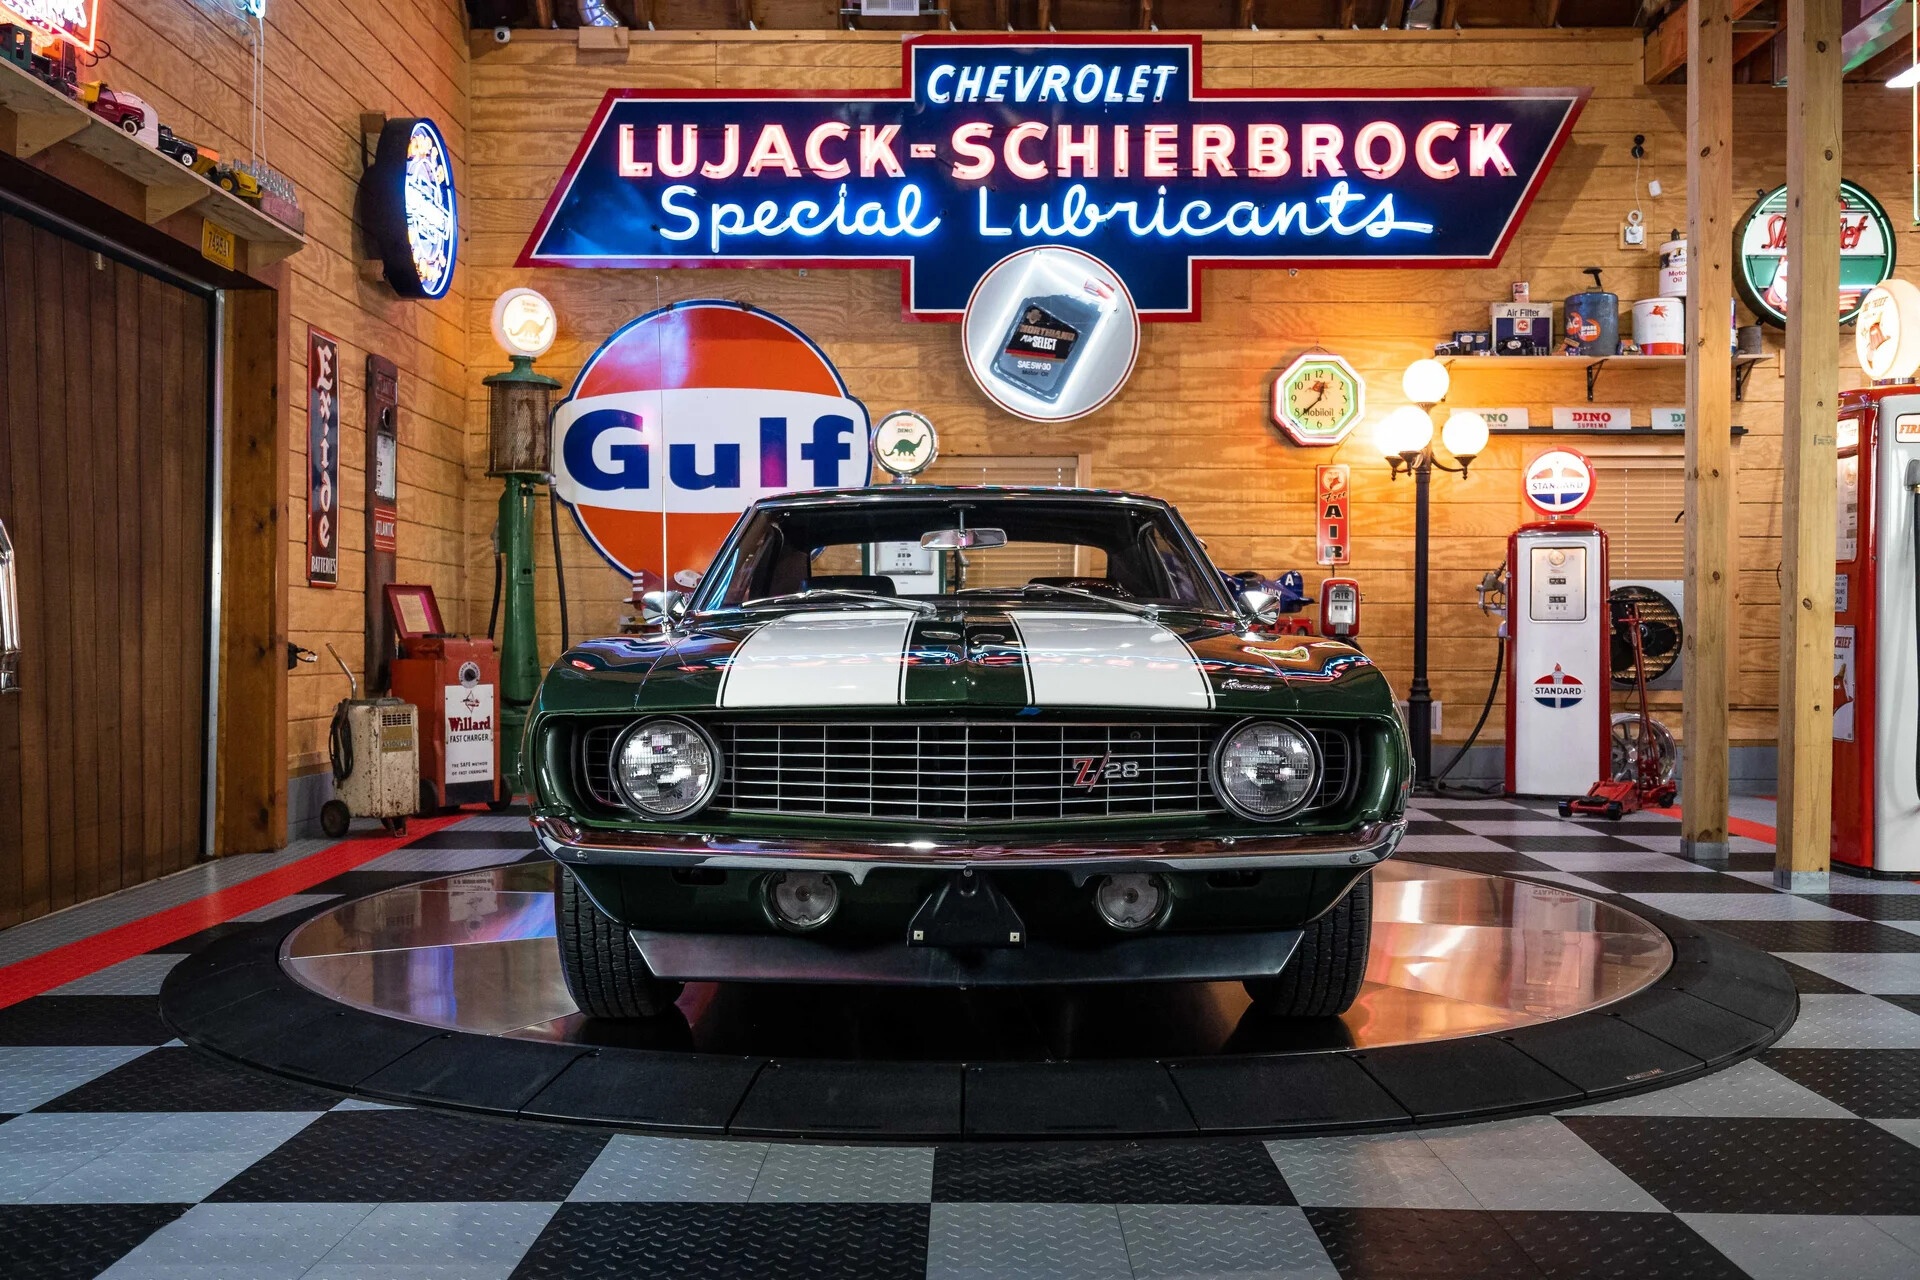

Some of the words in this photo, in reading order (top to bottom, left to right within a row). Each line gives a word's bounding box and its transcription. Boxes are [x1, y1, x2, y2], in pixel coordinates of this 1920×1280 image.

[927, 64, 1178, 103] CHEVROLET
[619, 121, 1517, 180] LUJACK-SCHIERBROCK
[659, 183, 941, 253] Special
[979, 181, 1434, 238] Lubricants
[1507, 309, 1518, 317] Air
[1520, 309, 1540, 317] Filter
[1566, 318, 1579, 329] AC
[1032, 336, 1058, 350] SELECT
[1304, 373, 1311, 381] 11
[1315, 369, 1324, 379] 12
[1294, 382, 1303, 390] 10
[1339, 382, 1344, 390] 2
[1291, 394, 1297, 402] 9
[1342, 394, 1348, 402] 3
[1294, 408, 1300, 417] 8
[1339, 408, 1344, 417] 4
[1572, 412, 1611, 422] DINO
[1304, 418, 1309, 426] 7
[1316, 421, 1323, 429] 6
[1331, 417, 1336, 425] 5
[563, 408, 854, 491] Gulf
[1323, 503, 1344, 559] AIR
[311, 556, 336, 575] BATTERIES
[1285, 574, 1294, 586] A
[1335, 592, 1350, 600] AIR
[1535, 687, 1582, 695] STANDARD
[448, 716, 491, 732] Willard
[450, 735, 462, 743] FAST
[463, 733, 489, 742] CHARGER
[1073, 750, 1140, 793] Z/28
